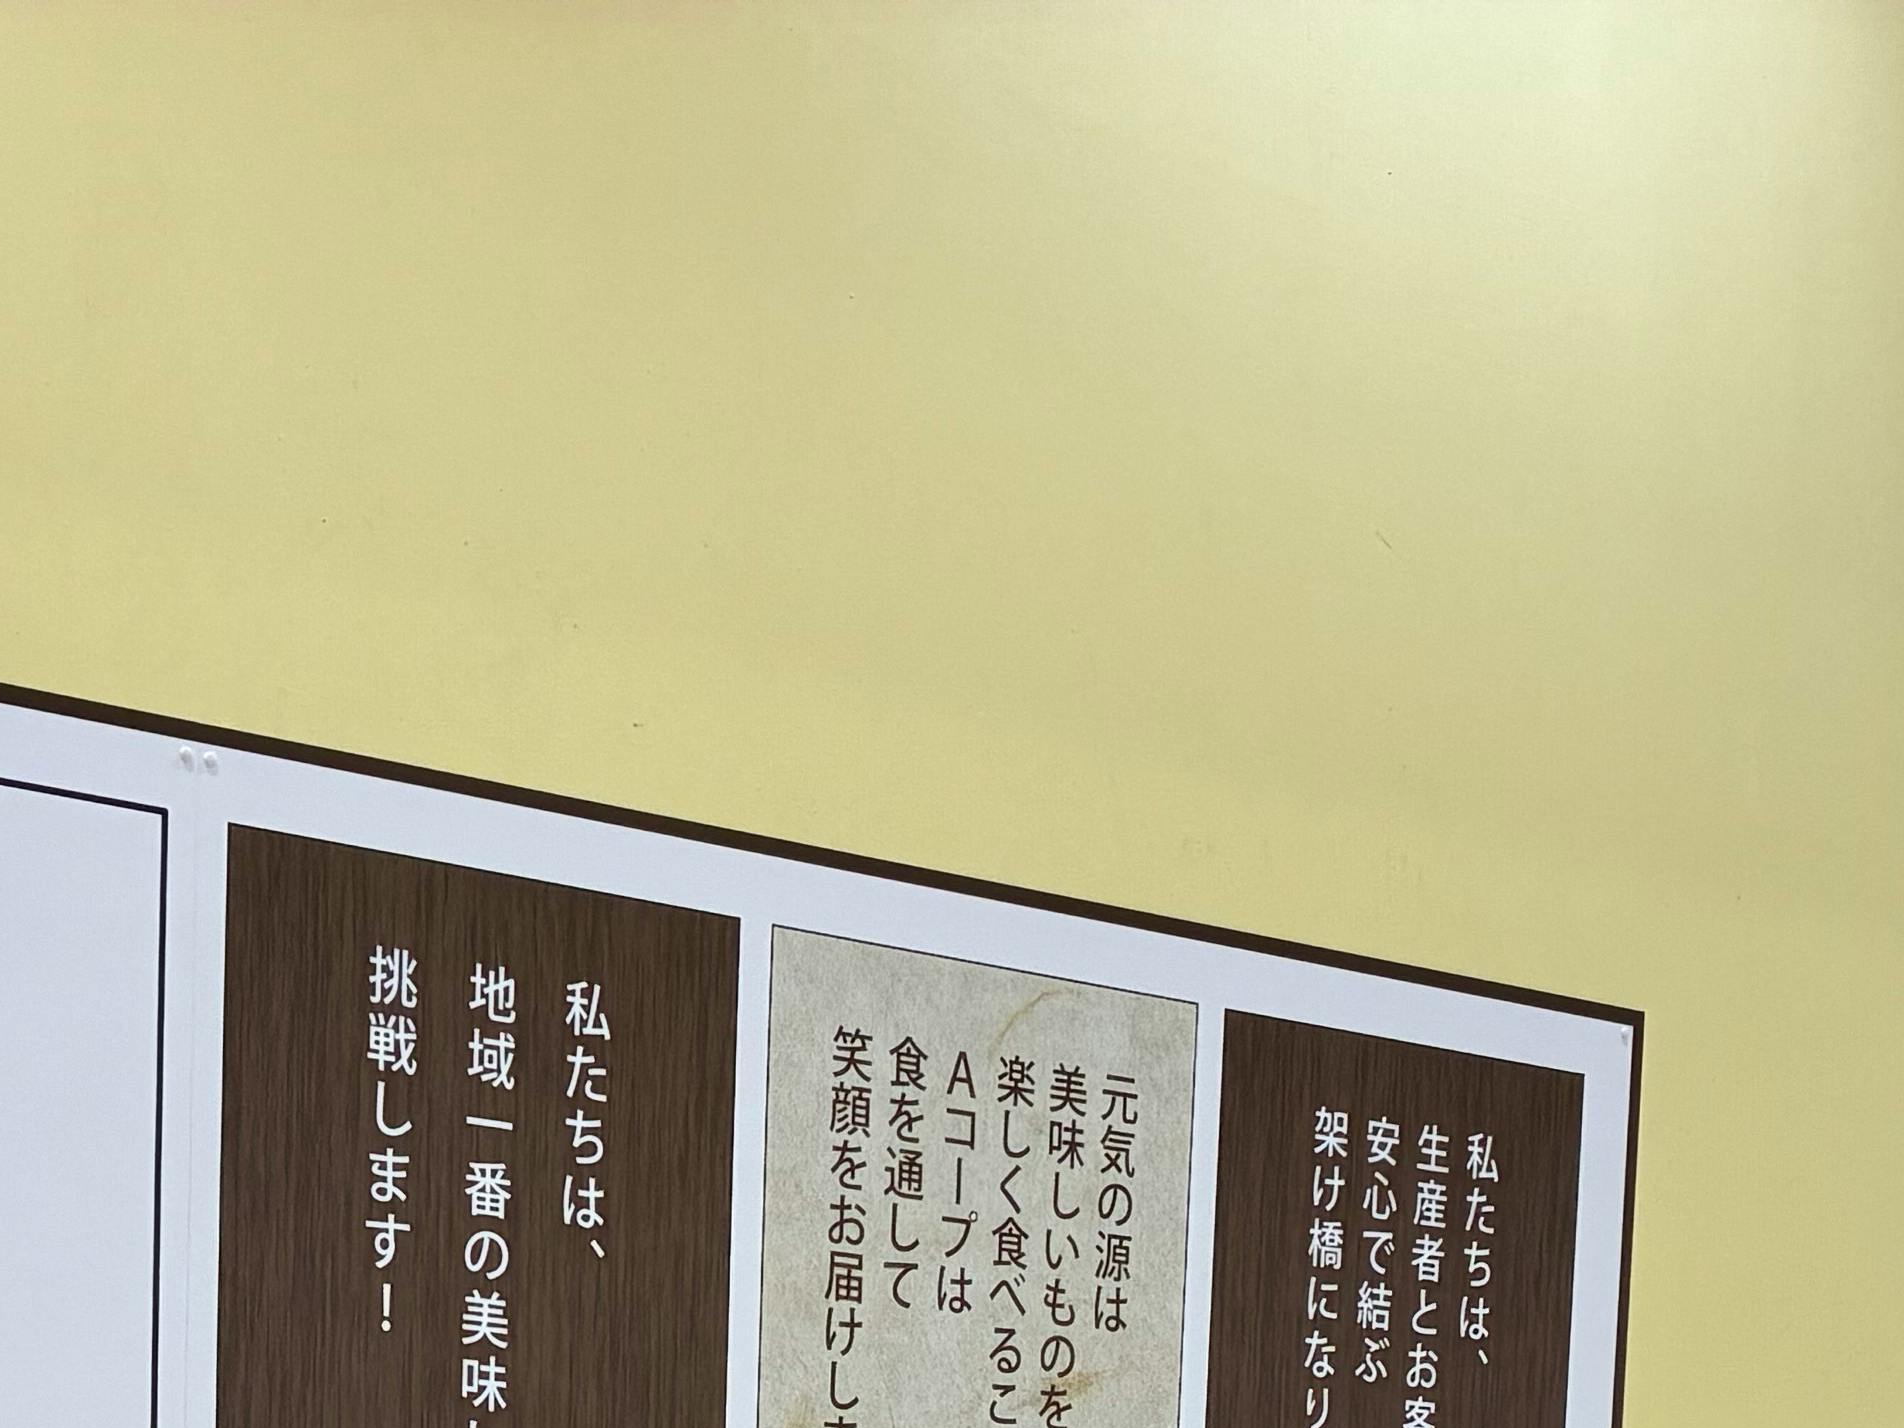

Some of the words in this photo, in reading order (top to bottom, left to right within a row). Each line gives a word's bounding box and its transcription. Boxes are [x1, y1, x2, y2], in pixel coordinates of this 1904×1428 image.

[561, 978, 612, 1262] 私たちは、
[881, 1035, 930, 1310] 食を通して
[936, 1049, 978, 1315] Aコープは
[1092, 1073, 1141, 1334] 元気の源は
[1354, 1115, 1401, 1384] 安心で結ぶ
[1458, 1131, 1500, 1366] 私たちは、
